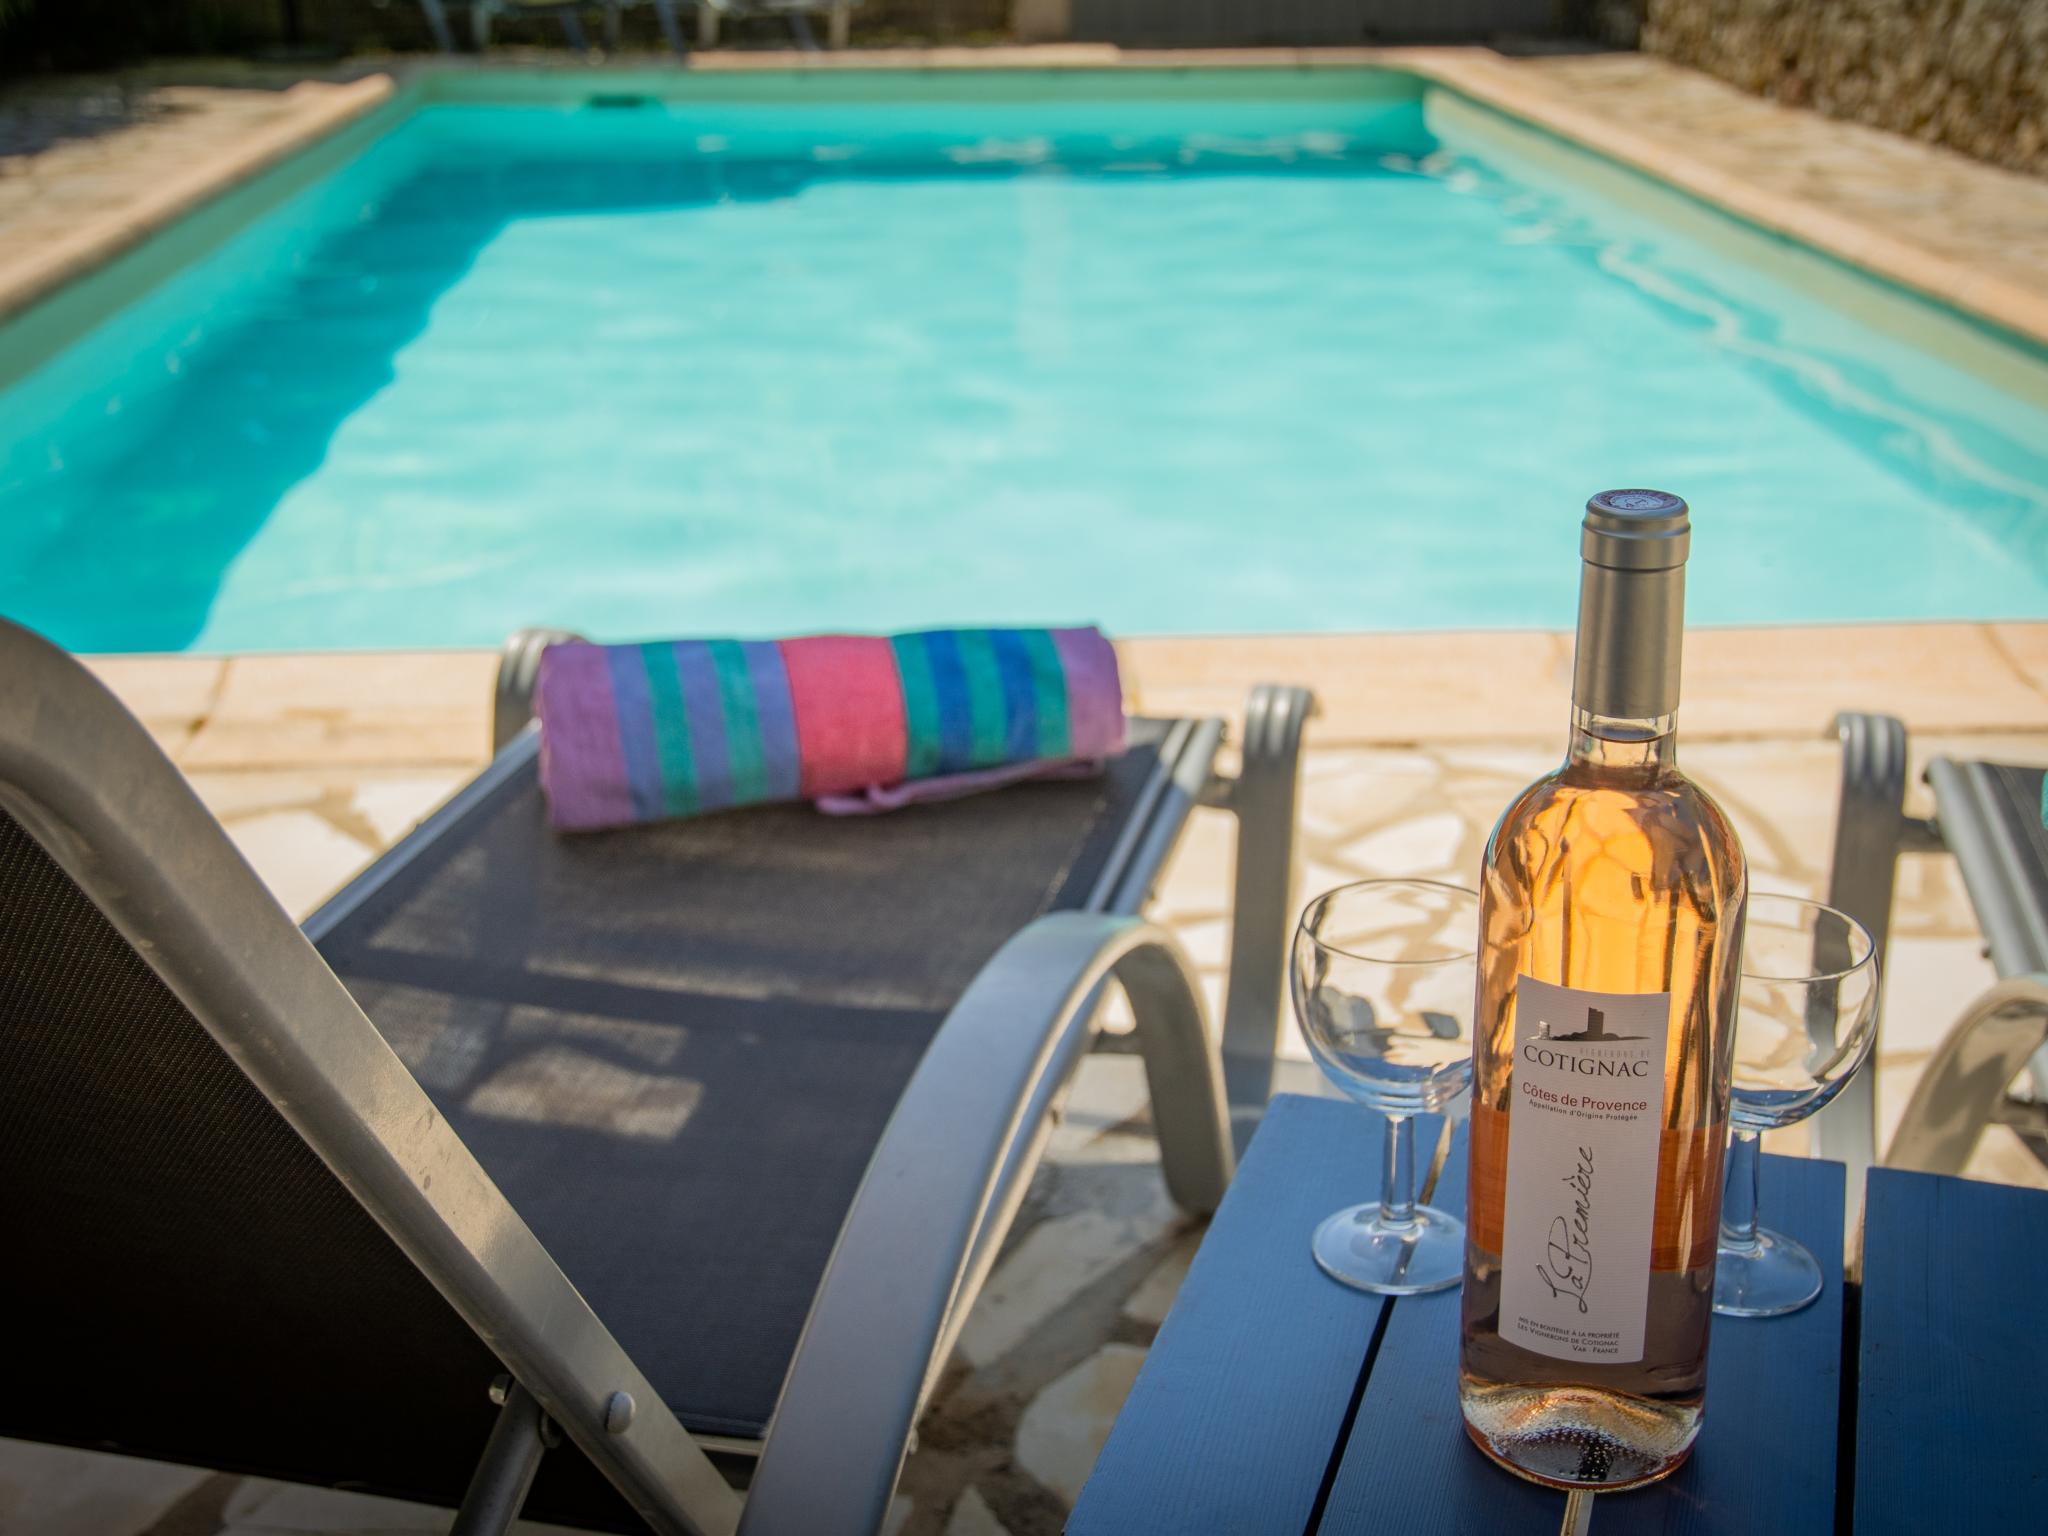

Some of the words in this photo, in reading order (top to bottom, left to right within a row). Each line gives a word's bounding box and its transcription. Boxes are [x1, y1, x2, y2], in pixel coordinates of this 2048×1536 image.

[1523, 1044, 1649, 1077] COTIGNAC
[1522, 1081, 1558, 1103] Côtes
[1560, 1093, 1578, 1107] de
[1581, 1096, 1647, 1111] Provence
[1528, 1098, 1567, 1115] Appellation
[1569, 1110, 1603, 1120] d'Origine
[1547, 1146, 1593, 1279] Première
[1535, 1258, 1592, 1314] La
[1529, 1327, 1569, 1343] VIGNERONS
[1581, 1338, 1619, 1346] COTIGNAC
[1592, 1346, 1619, 1354] FRANCE
